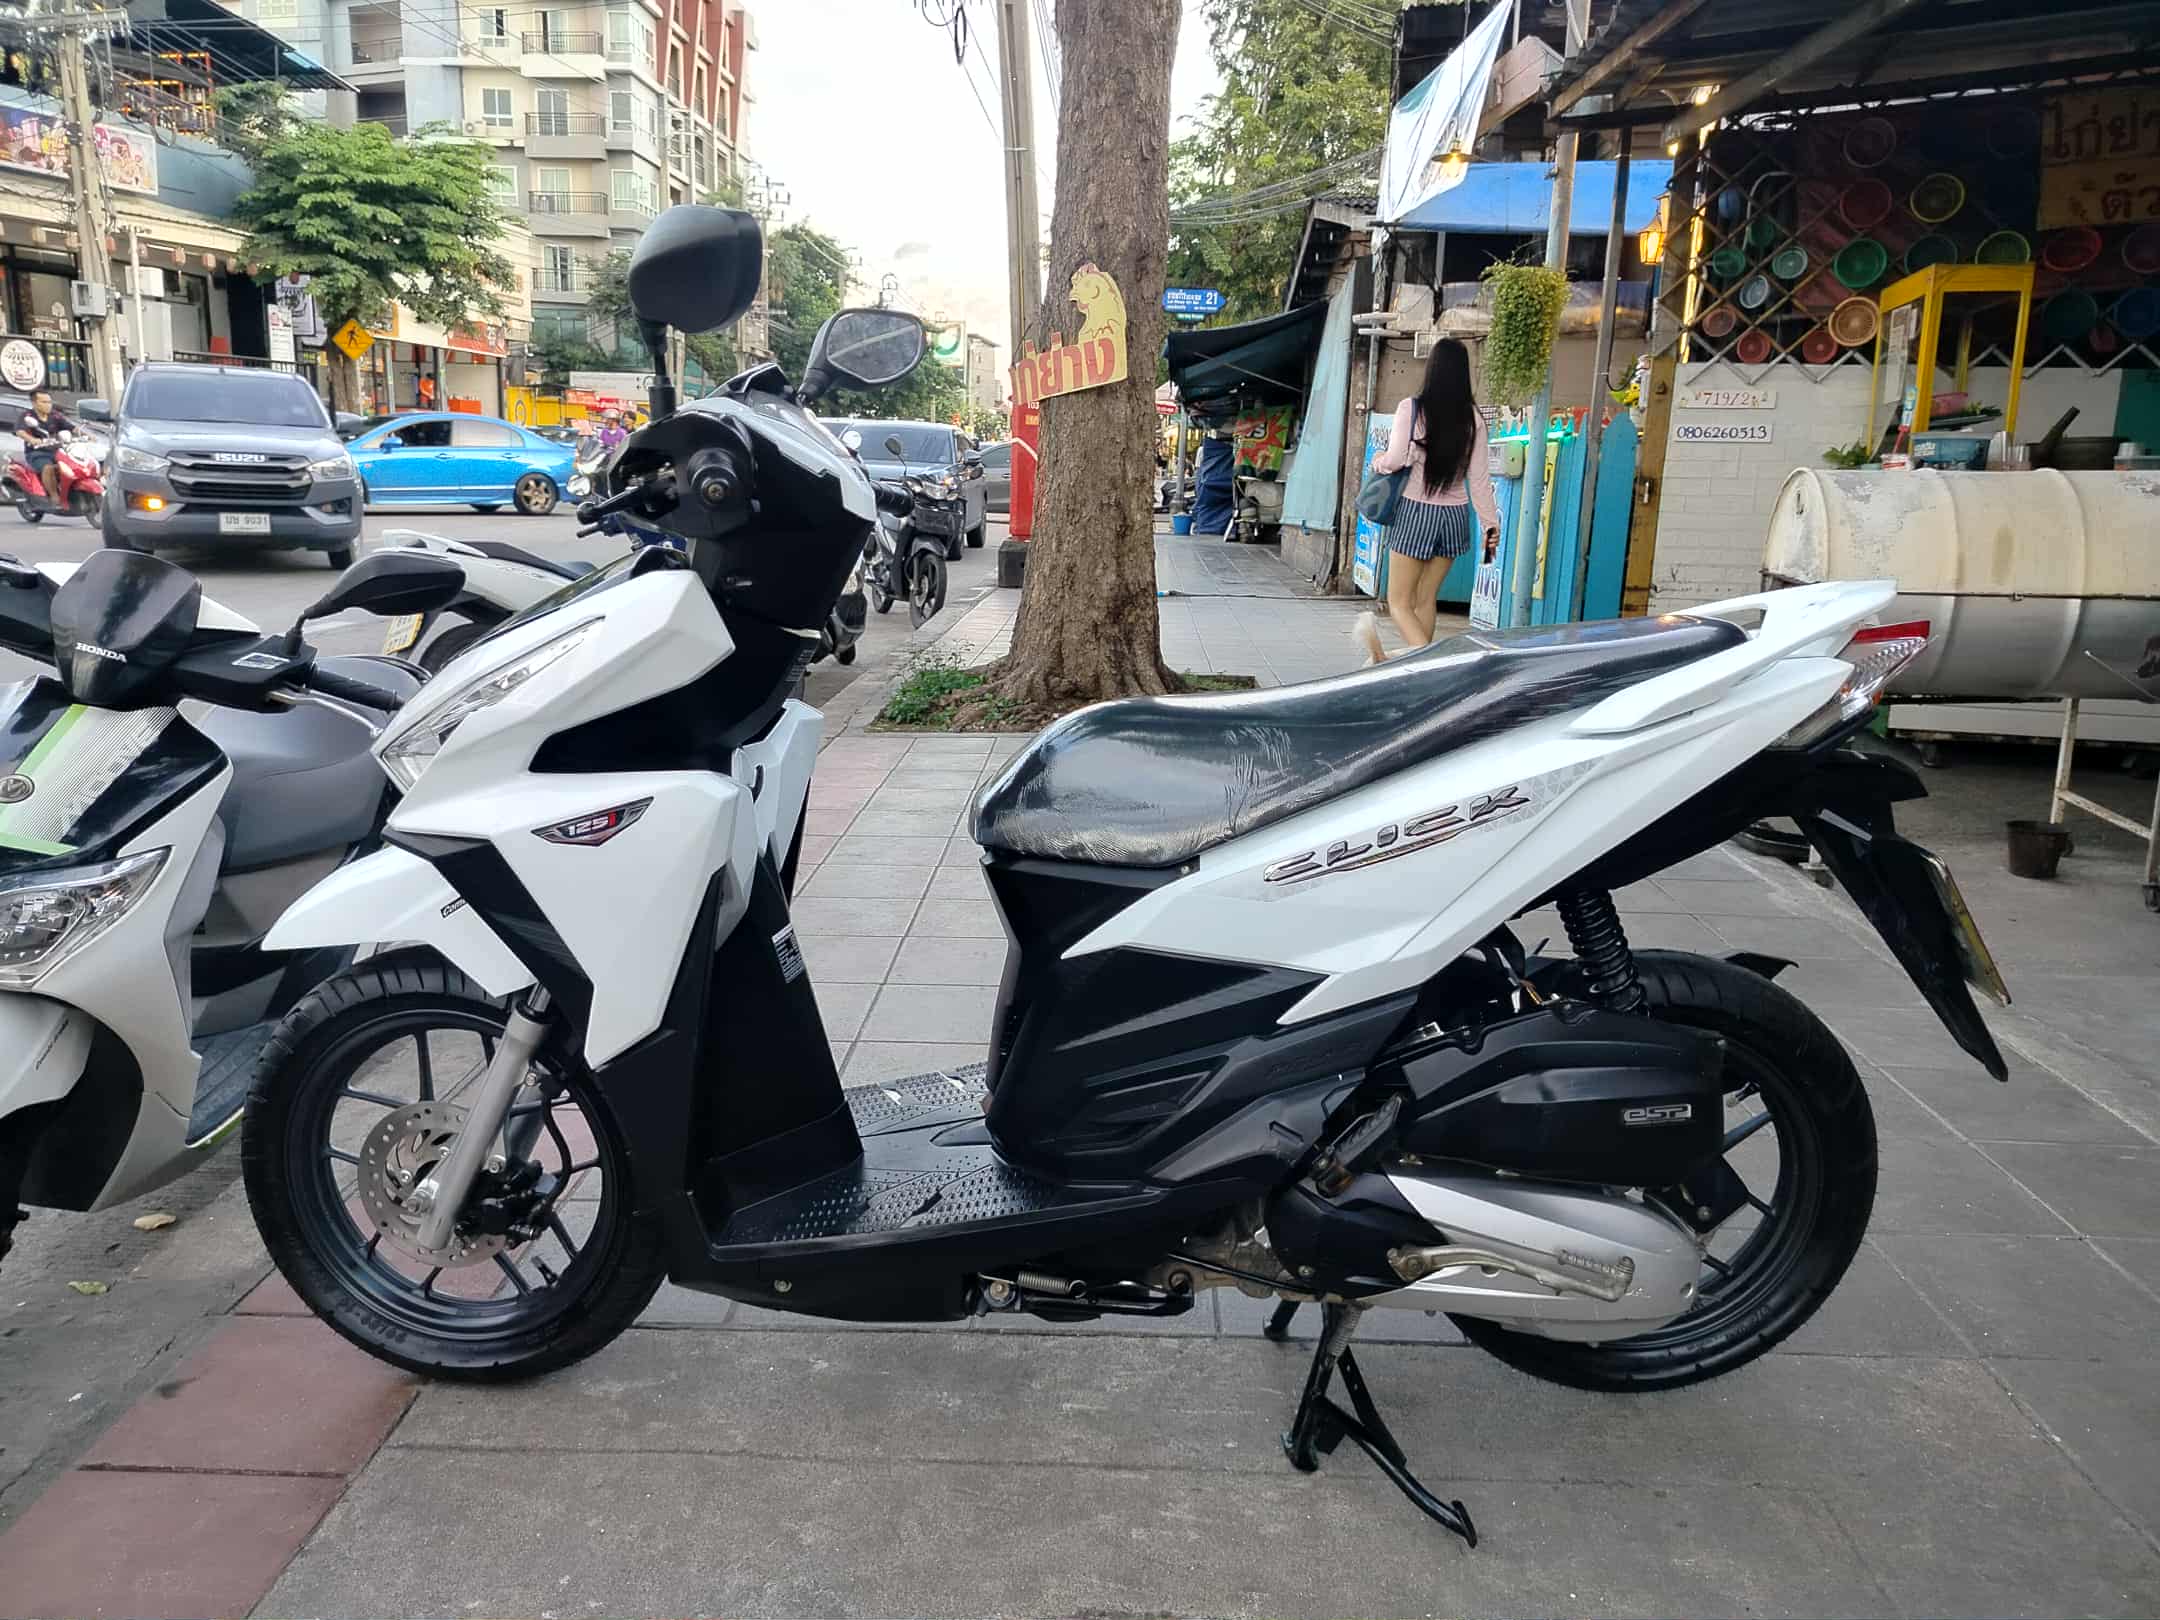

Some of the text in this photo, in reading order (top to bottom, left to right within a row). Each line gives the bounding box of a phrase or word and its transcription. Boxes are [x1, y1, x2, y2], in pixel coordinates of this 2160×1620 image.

[1206, 291, 1218, 305] 21
[1676, 425, 1768, 439] 0806260513
[214, 453, 266, 463] ISUZU
[75, 642, 128, 664] HONDA
